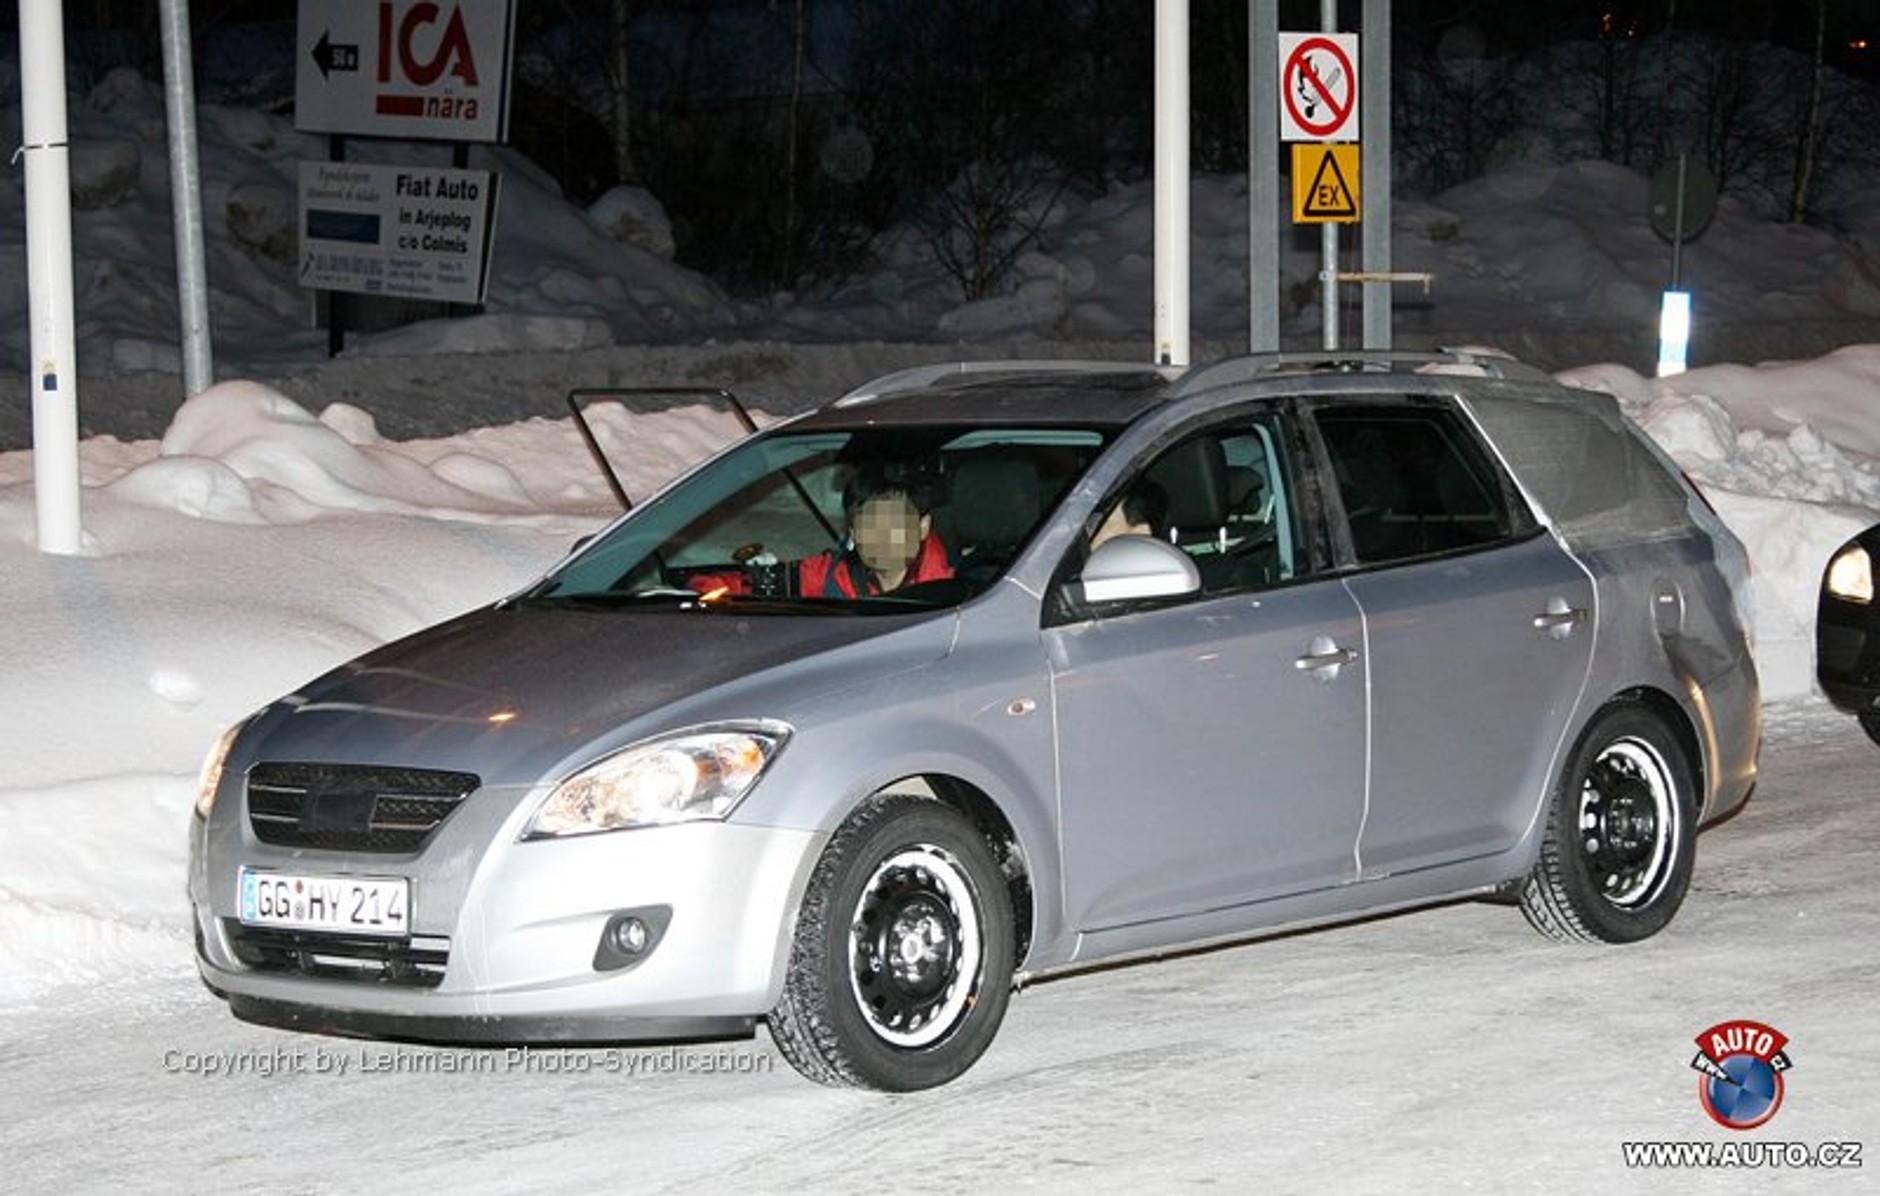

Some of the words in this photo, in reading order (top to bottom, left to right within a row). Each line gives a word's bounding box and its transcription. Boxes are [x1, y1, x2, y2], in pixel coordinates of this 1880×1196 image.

[376, 1, 479, 87] ICA
[425, 88, 479, 120] nära
[396, 174, 431, 198] Fiat
[436, 176, 479, 201] Auto
[1318, 185, 1340, 207] EX
[415, 208, 472, 233] Arjeplog
[422, 235, 469, 253] Colmis
[258, 880, 291, 918] GG
[308, 883, 342, 922] HY
[350, 886, 403, 925] 214
